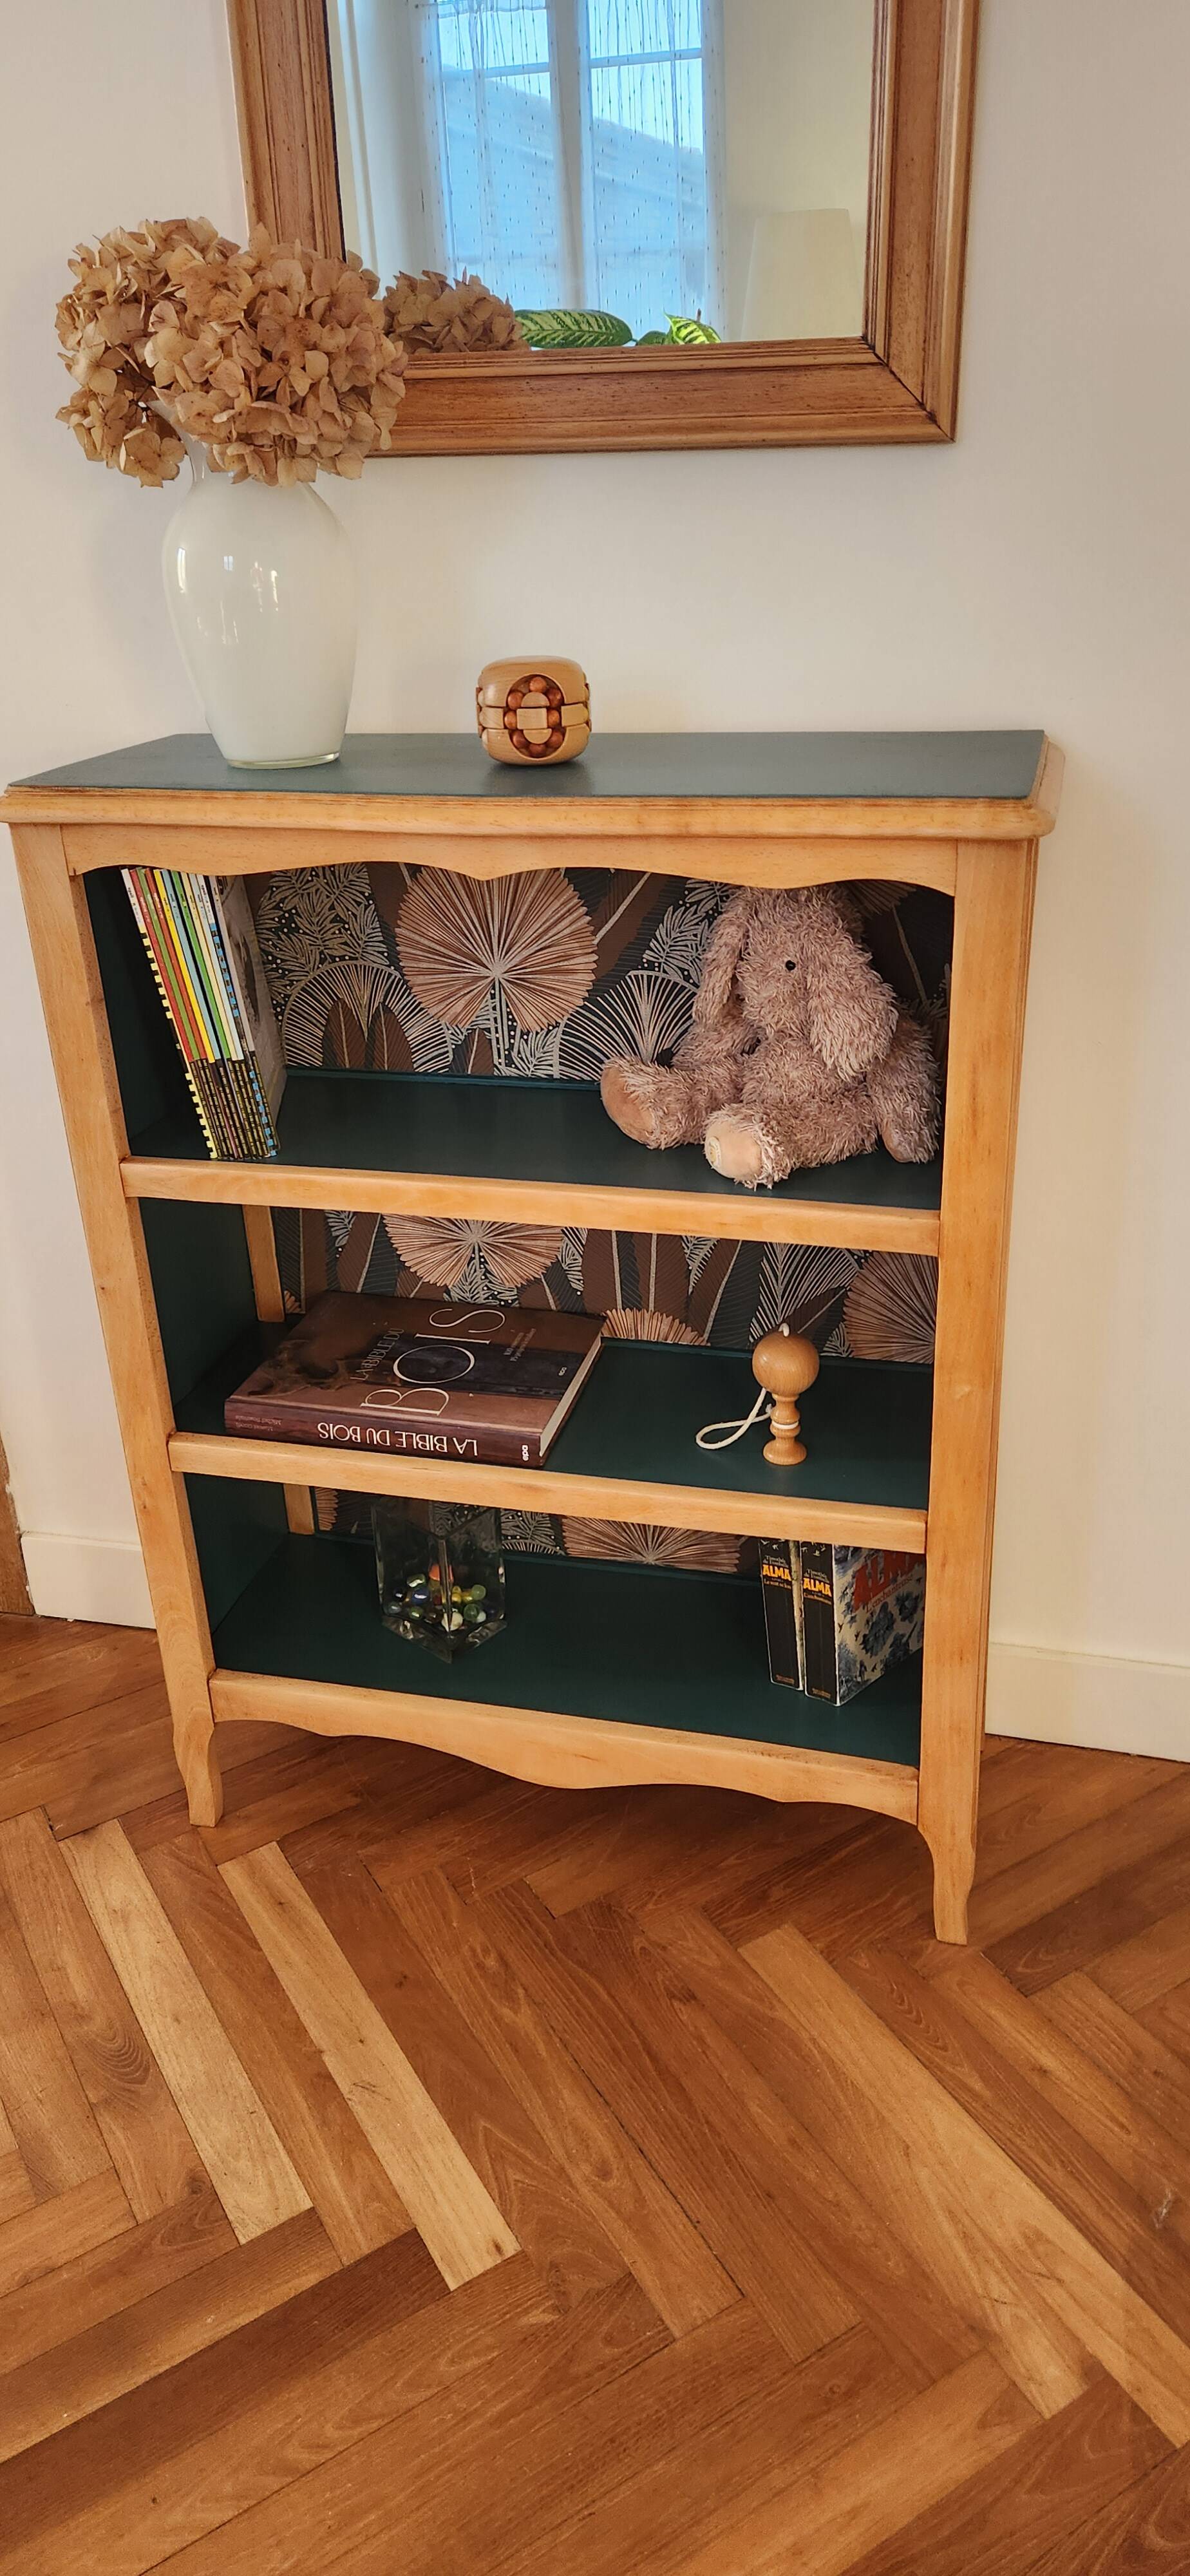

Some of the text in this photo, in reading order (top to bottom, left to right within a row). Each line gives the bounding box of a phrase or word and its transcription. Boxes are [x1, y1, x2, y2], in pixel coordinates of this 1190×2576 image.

[350, 1328, 404, 1381] LA BIBLE DU
[360, 1308, 506, 1416] BOIS
[317, 1422, 478, 1456] LA BIBLE DU BOIS
[762, 1564, 792, 1581] ALMA
[803, 1578, 832, 1598] ALMA
